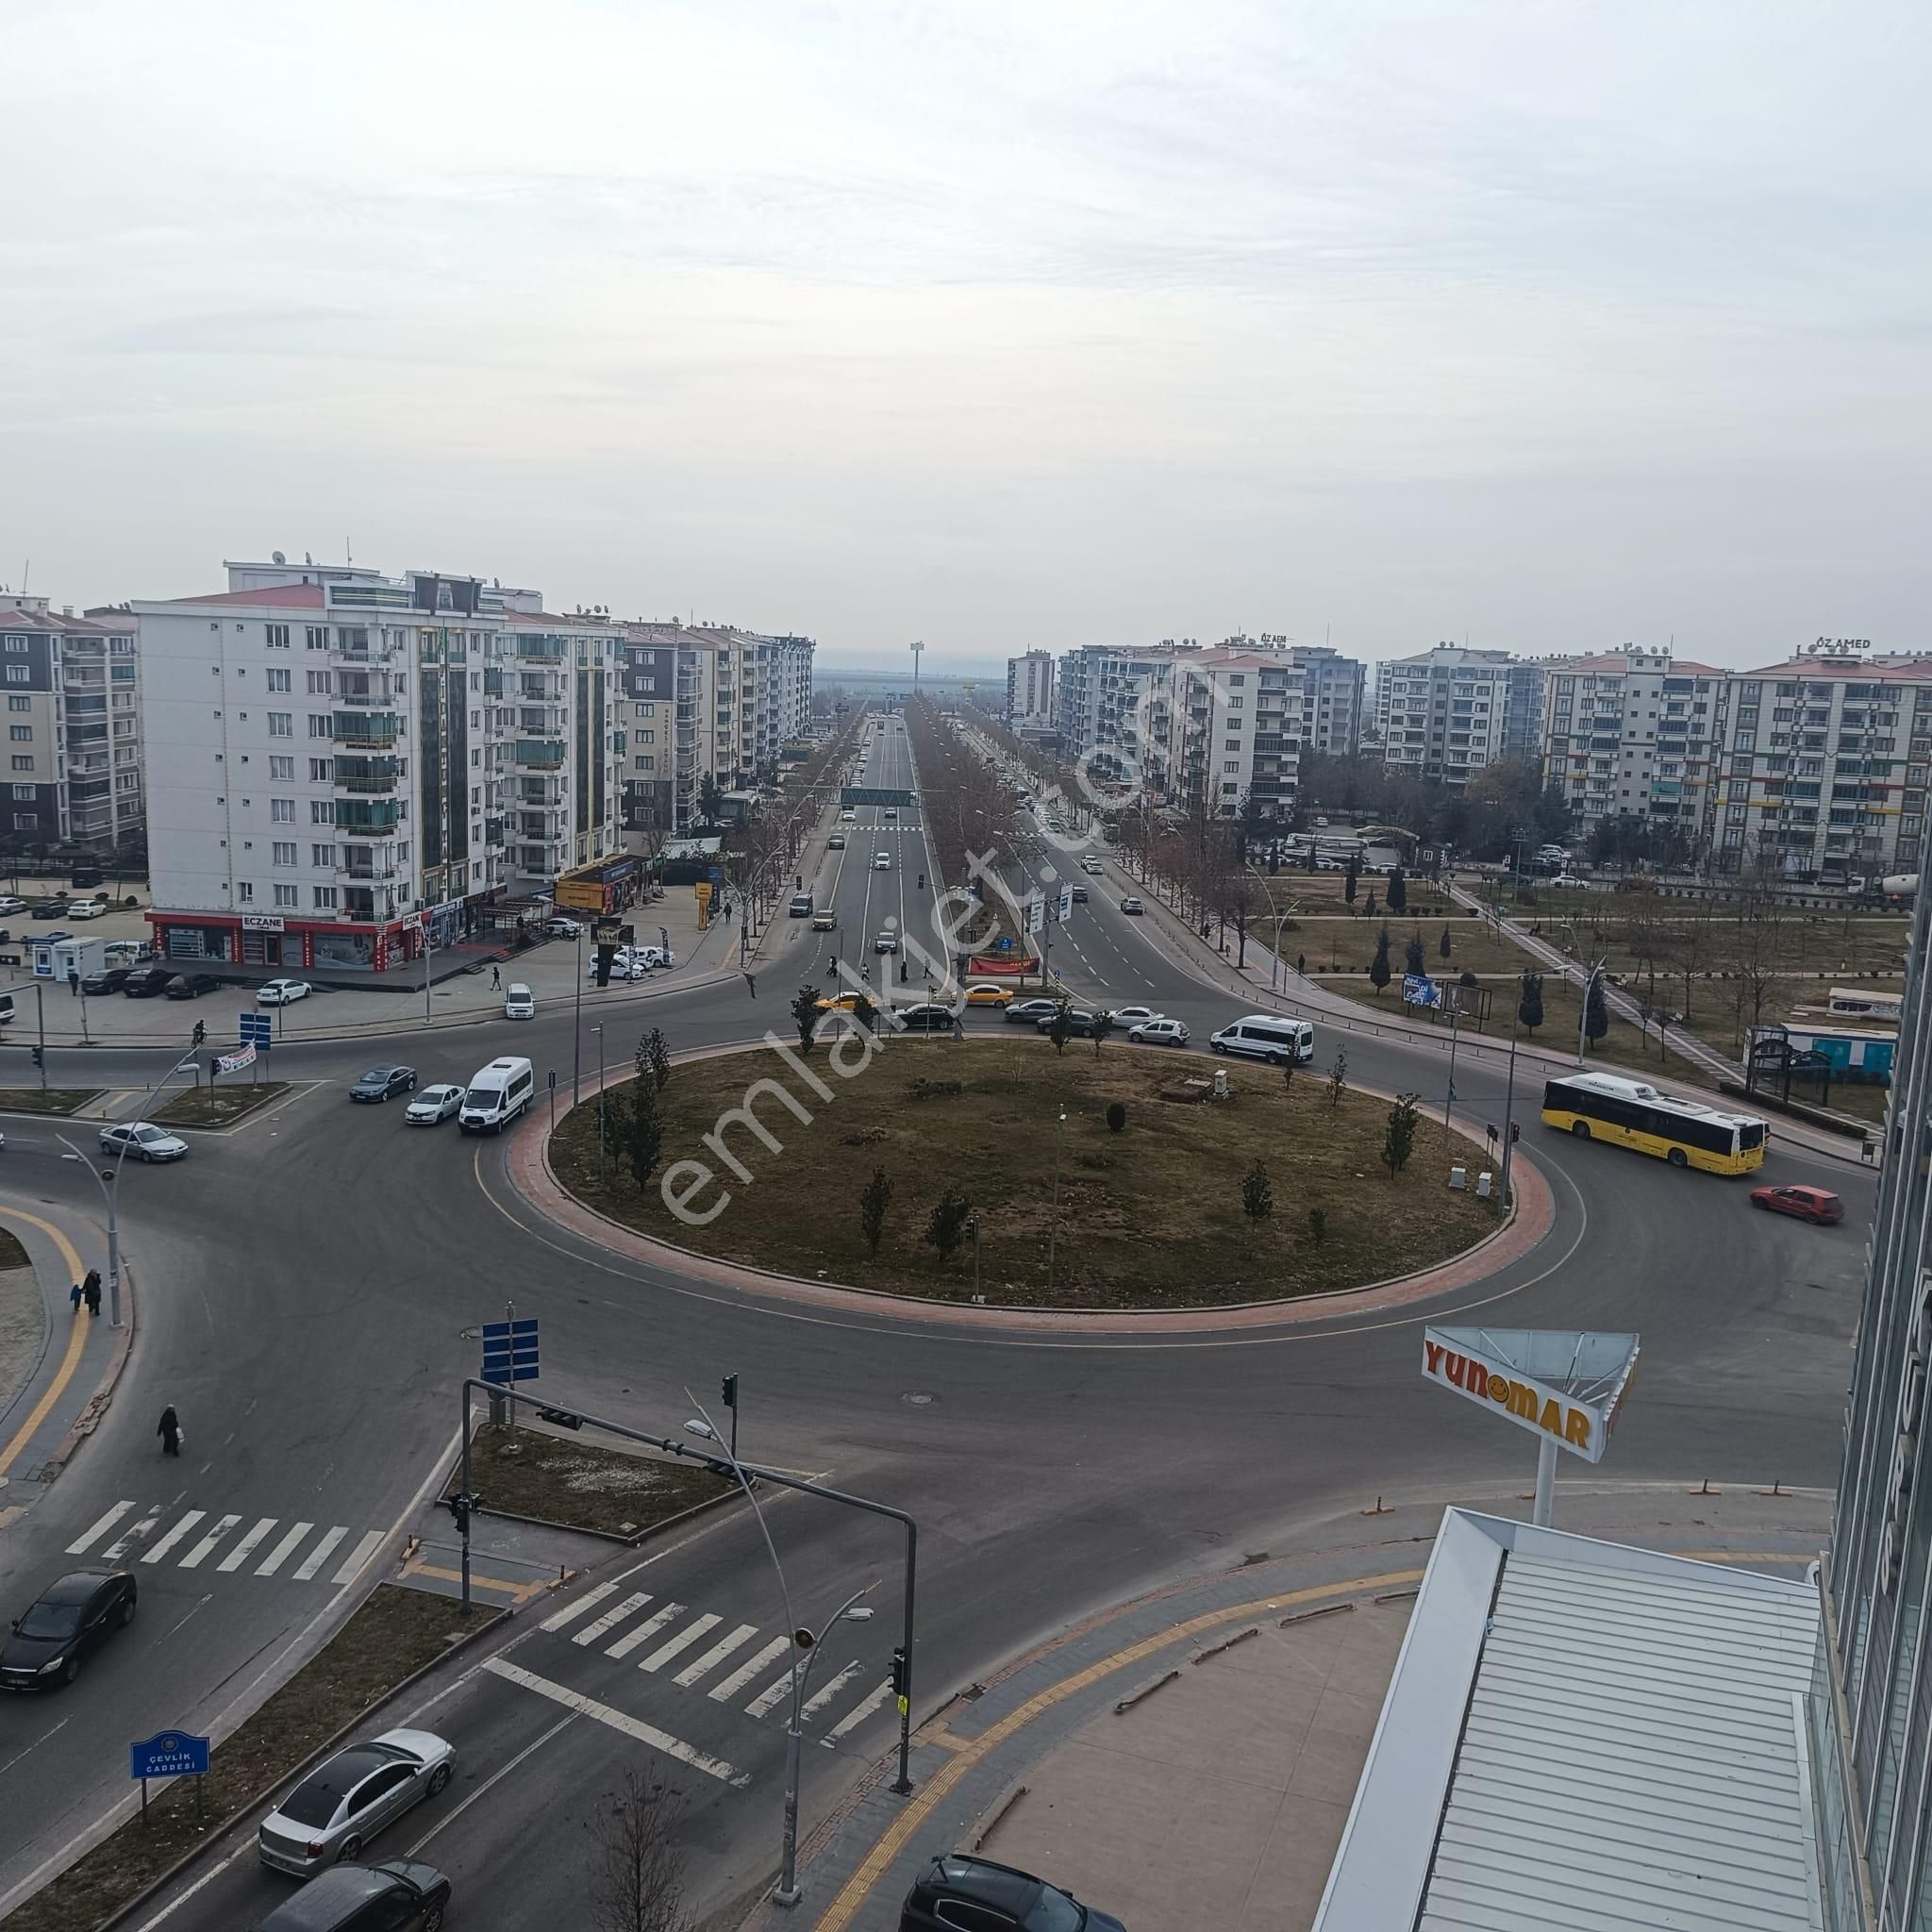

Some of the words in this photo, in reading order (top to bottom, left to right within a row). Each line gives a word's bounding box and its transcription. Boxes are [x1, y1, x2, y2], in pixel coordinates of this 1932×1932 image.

[1817, 637, 1831, 648] ÖZ
[1836, 639, 1871, 649] AMED
[243, 917, 282, 927] ECZANE
[149, 1752, 192, 1764] ÇEVLİK
[146, 1760, 195, 1773] CADDESİ
